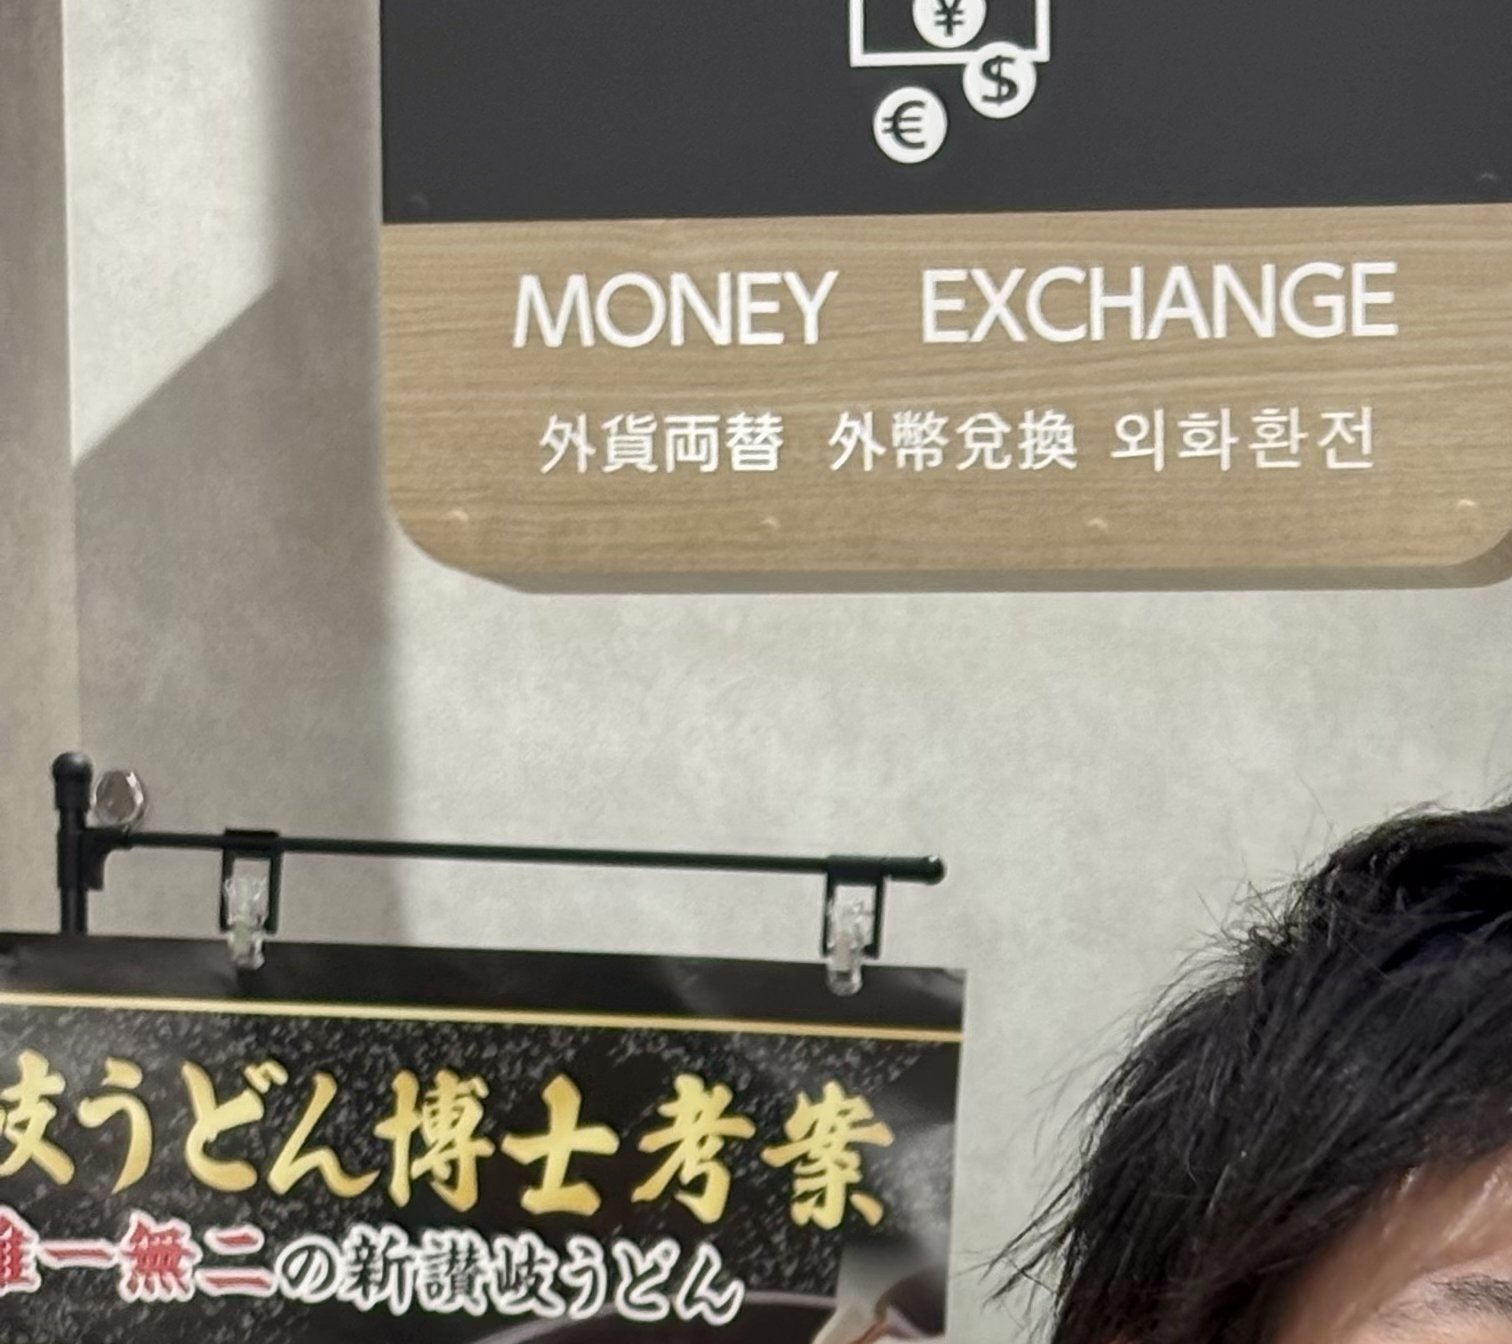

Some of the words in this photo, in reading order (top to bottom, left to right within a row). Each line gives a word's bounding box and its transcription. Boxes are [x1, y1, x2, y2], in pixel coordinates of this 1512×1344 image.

[511, 270, 838, 348] MONEY
[920, 261, 1398, 344] EXCHANGE
[539, 412, 784, 475] 外貨両替
[1110, 406, 1375, 471] 외화환전
